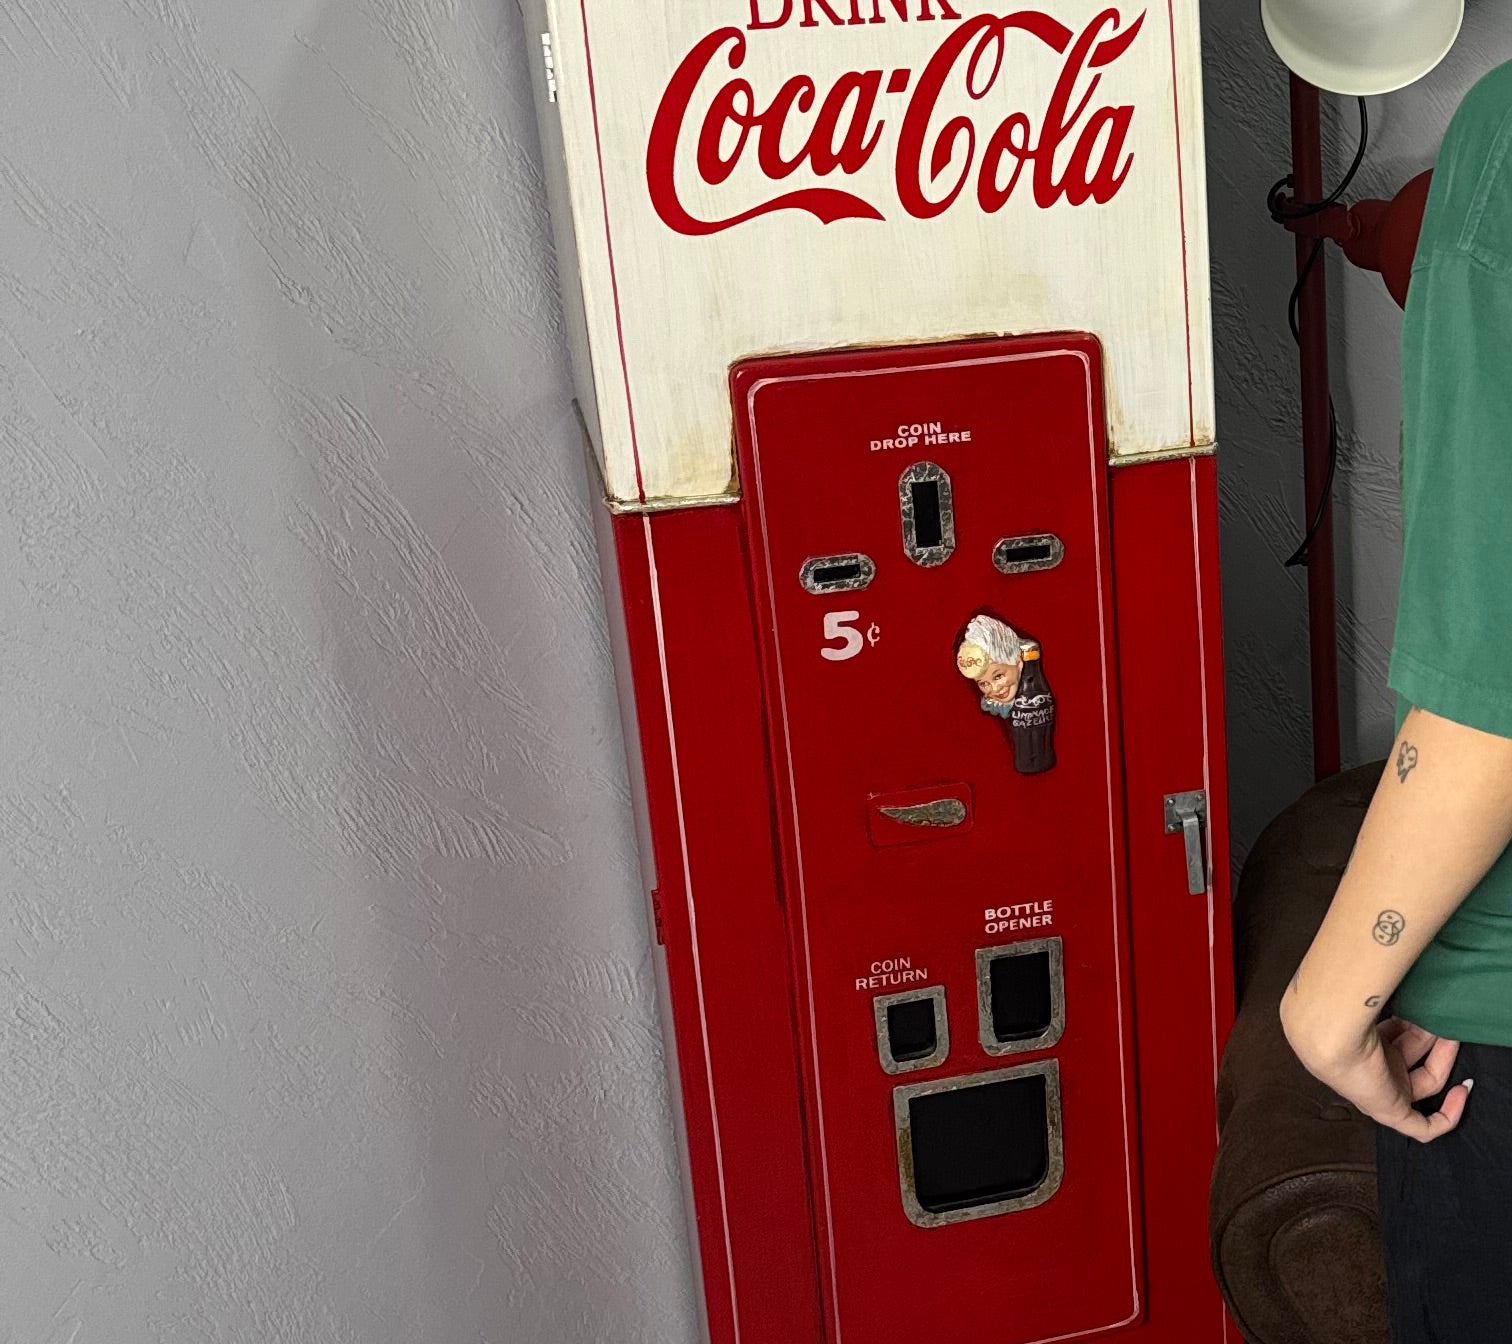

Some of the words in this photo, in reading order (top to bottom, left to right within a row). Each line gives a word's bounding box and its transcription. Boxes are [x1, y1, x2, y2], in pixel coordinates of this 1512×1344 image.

[646, 7, 1147, 236] Coca-Cola
[897, 421, 941, 437] COIN
[870, 436, 918, 451] DROP
[924, 431, 972, 446] HERE
[984, 899, 1053, 921] BOTTLE
[984, 914, 1053, 934] OPENER
[870, 957, 911, 974] COIN
[855, 968, 928, 991] RETURN
